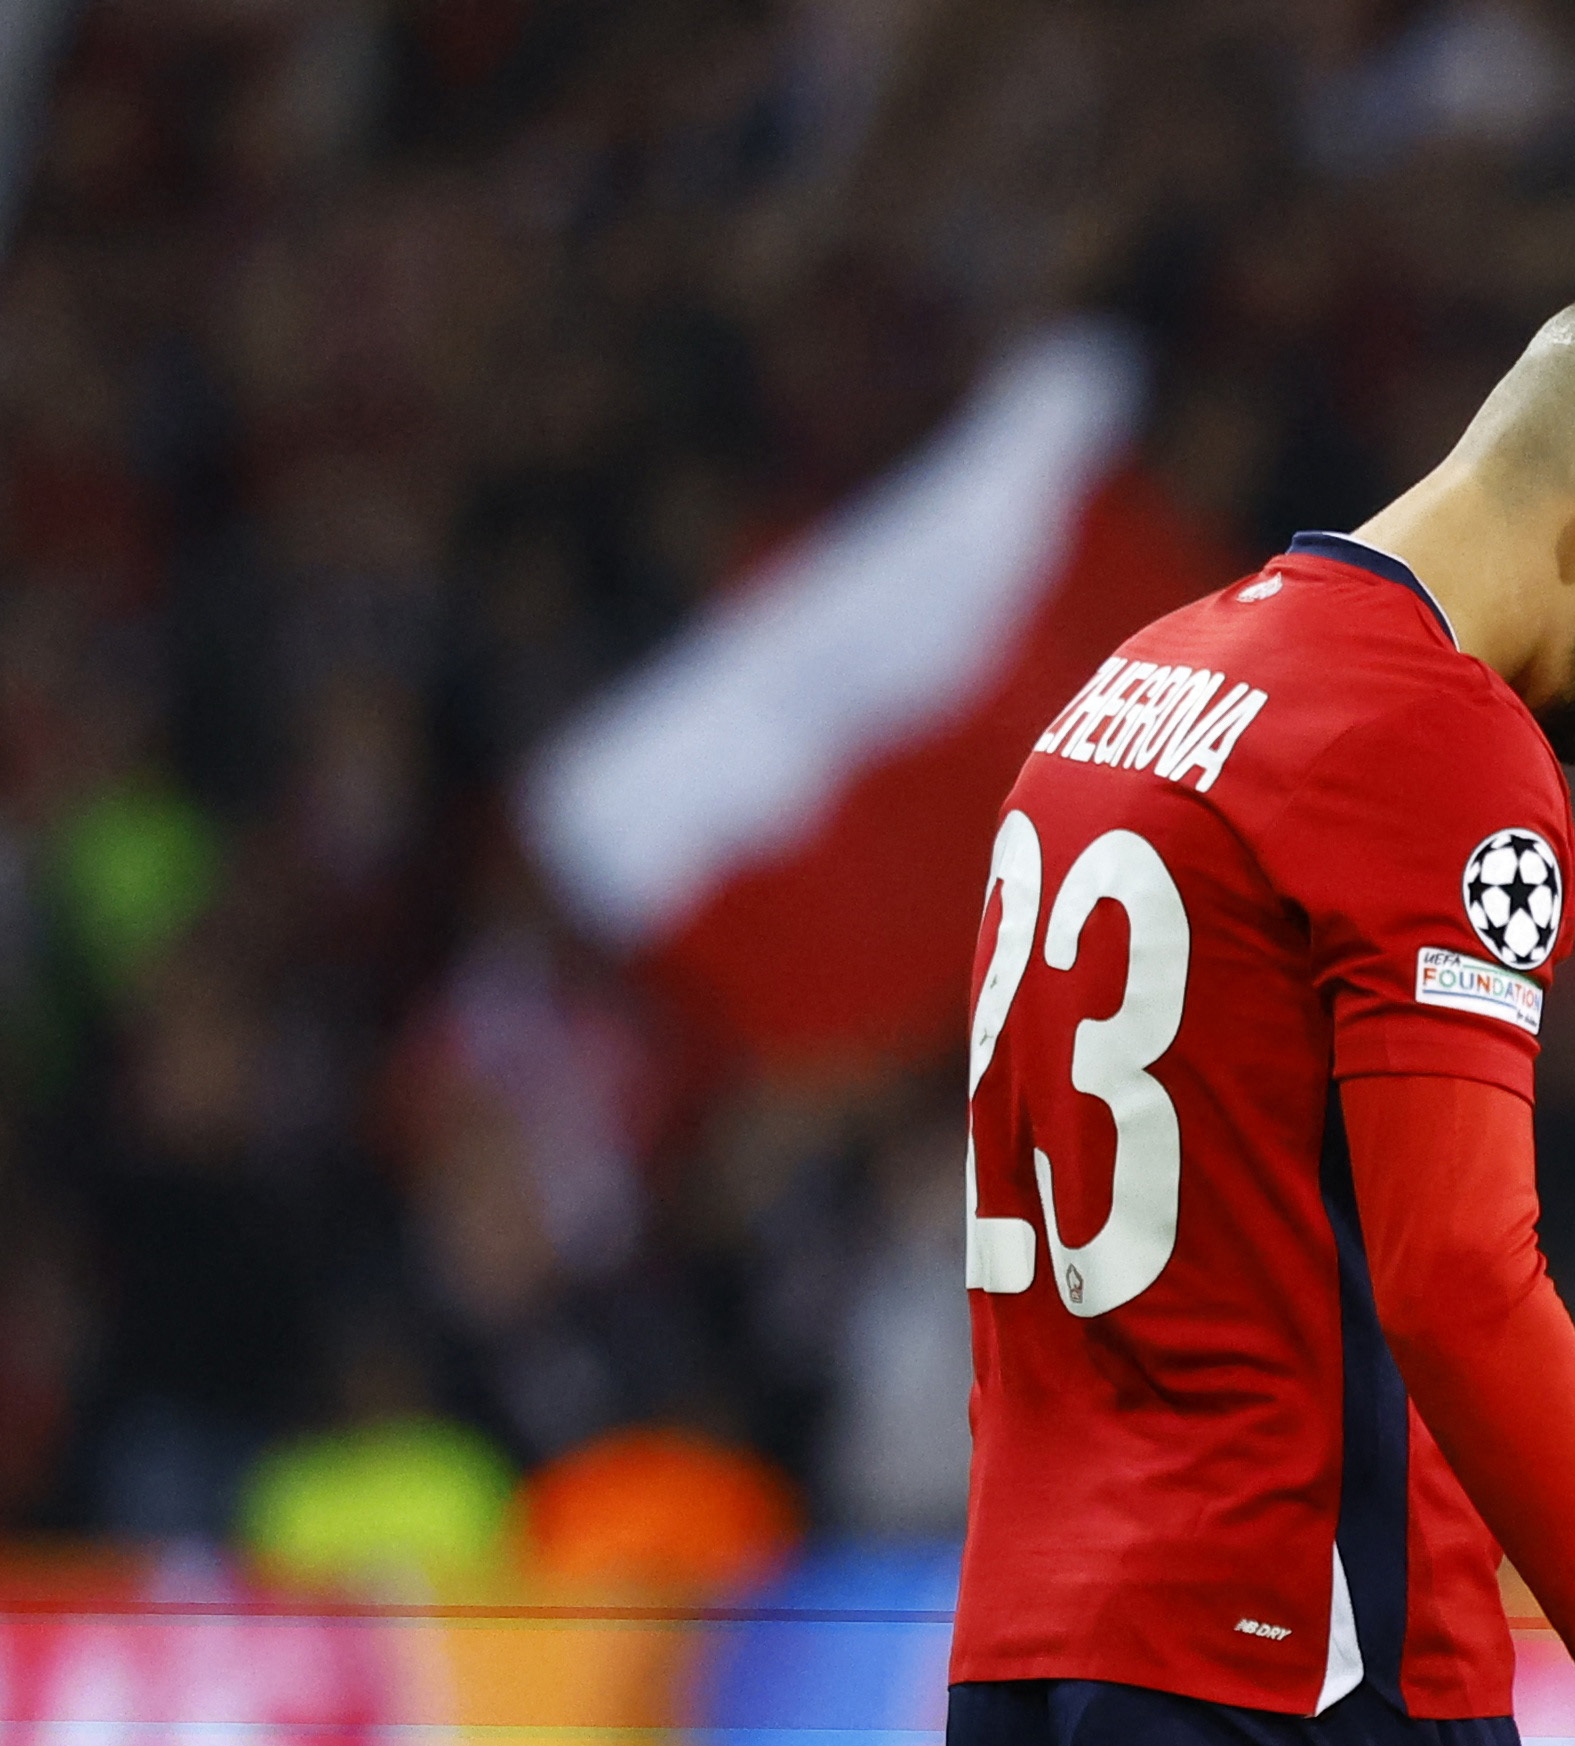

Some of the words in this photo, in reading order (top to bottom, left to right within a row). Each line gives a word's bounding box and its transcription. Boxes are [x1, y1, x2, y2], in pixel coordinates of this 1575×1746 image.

[1034, 656, 1268, 793] ZHEGROVA
[1422, 967, 1542, 1011] FOUNDATION
[1423, 951, 1461, 966] UEFA
[965, 809, 1191, 1318] 23
